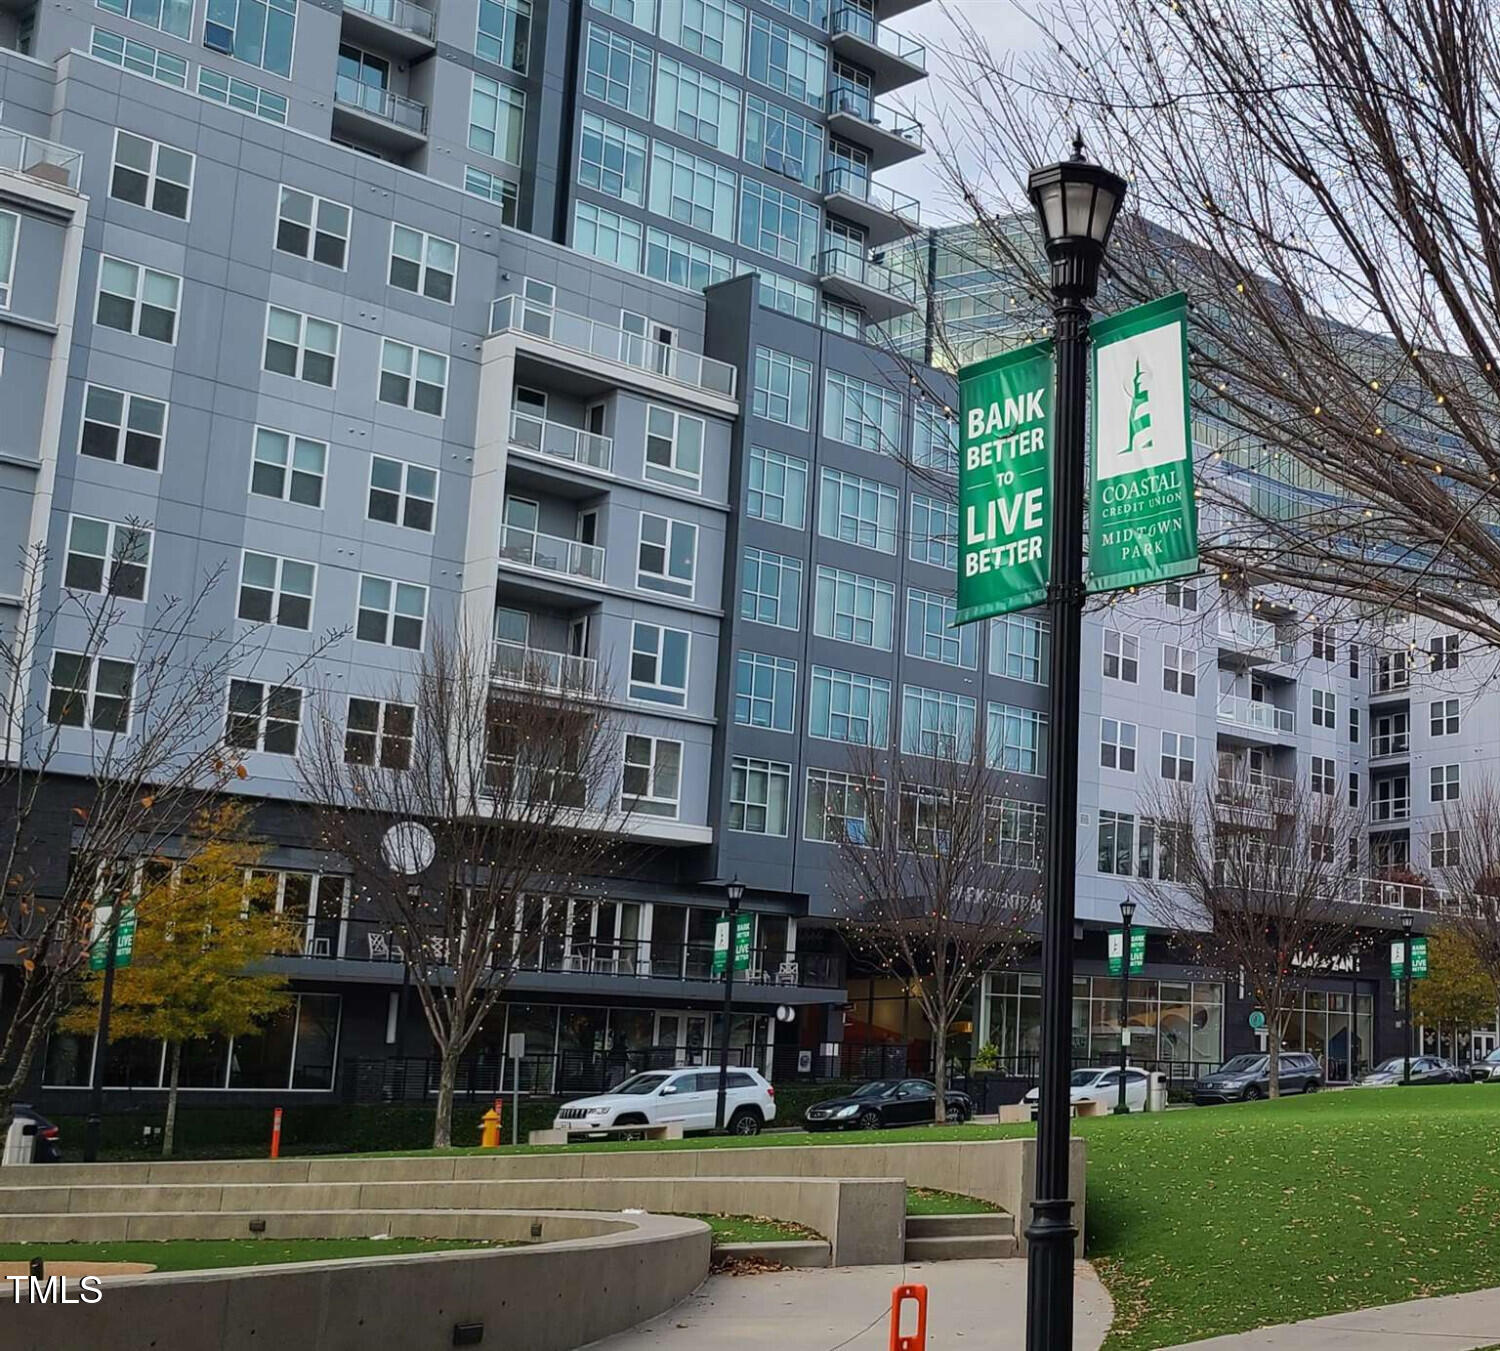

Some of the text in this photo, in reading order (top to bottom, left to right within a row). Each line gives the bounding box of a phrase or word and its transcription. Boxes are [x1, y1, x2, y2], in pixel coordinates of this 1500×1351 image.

[968, 388, 1045, 439] BANK
[967, 427, 1045, 471] BETTER
[996, 470, 1014, 488] TO
[1102, 471, 1182, 504] COASTAL
[967, 487, 1043, 546] LIVE
[1102, 492, 1182, 518] CREDIT UNION
[1102, 517, 1182, 547] MIDTOWN
[965, 535, 1043, 578] BETTER
[1122, 539, 1163, 560] PARK
[1412, 959, 1428, 967] LIVE
